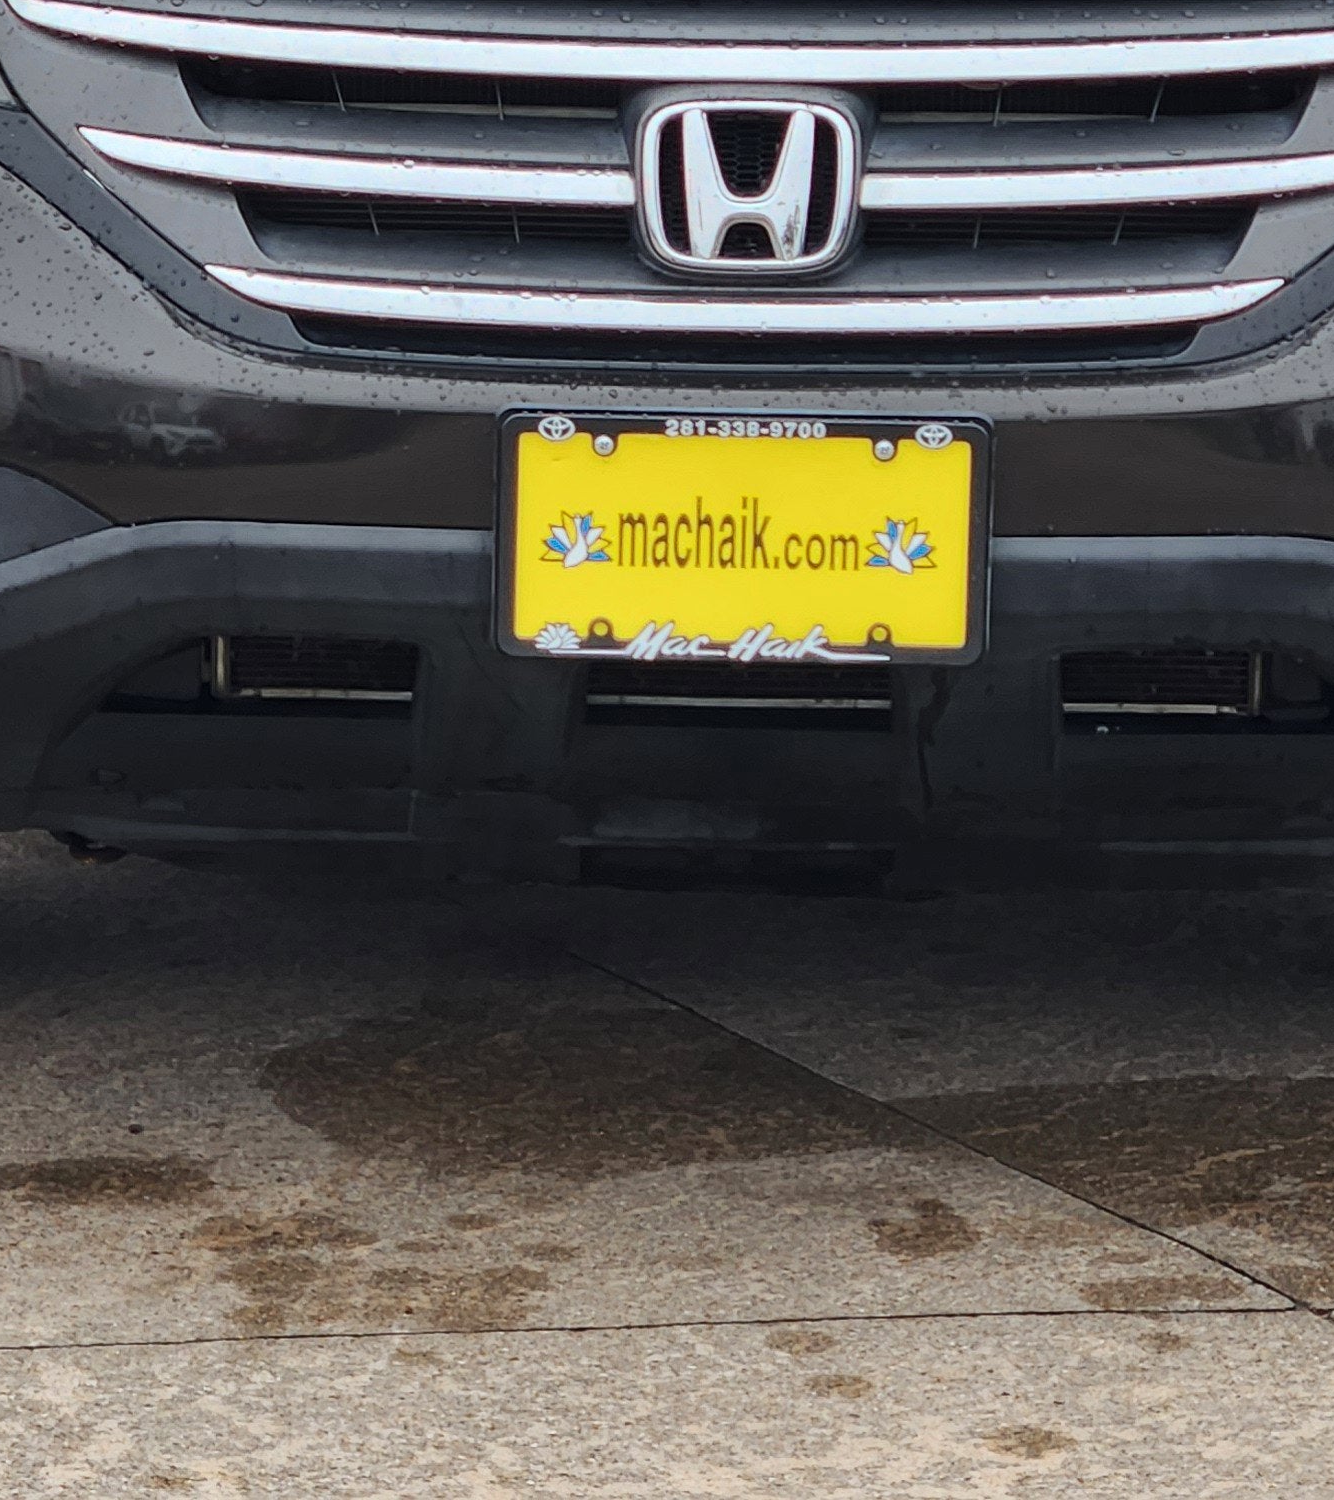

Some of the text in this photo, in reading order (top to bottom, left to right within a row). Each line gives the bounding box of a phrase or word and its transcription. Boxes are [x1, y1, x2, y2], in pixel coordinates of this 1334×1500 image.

[664, 418, 827, 439] 281-338-9700
[617, 496, 860, 572] machaik.com
[624, 619, 857, 662] Mac Haik
